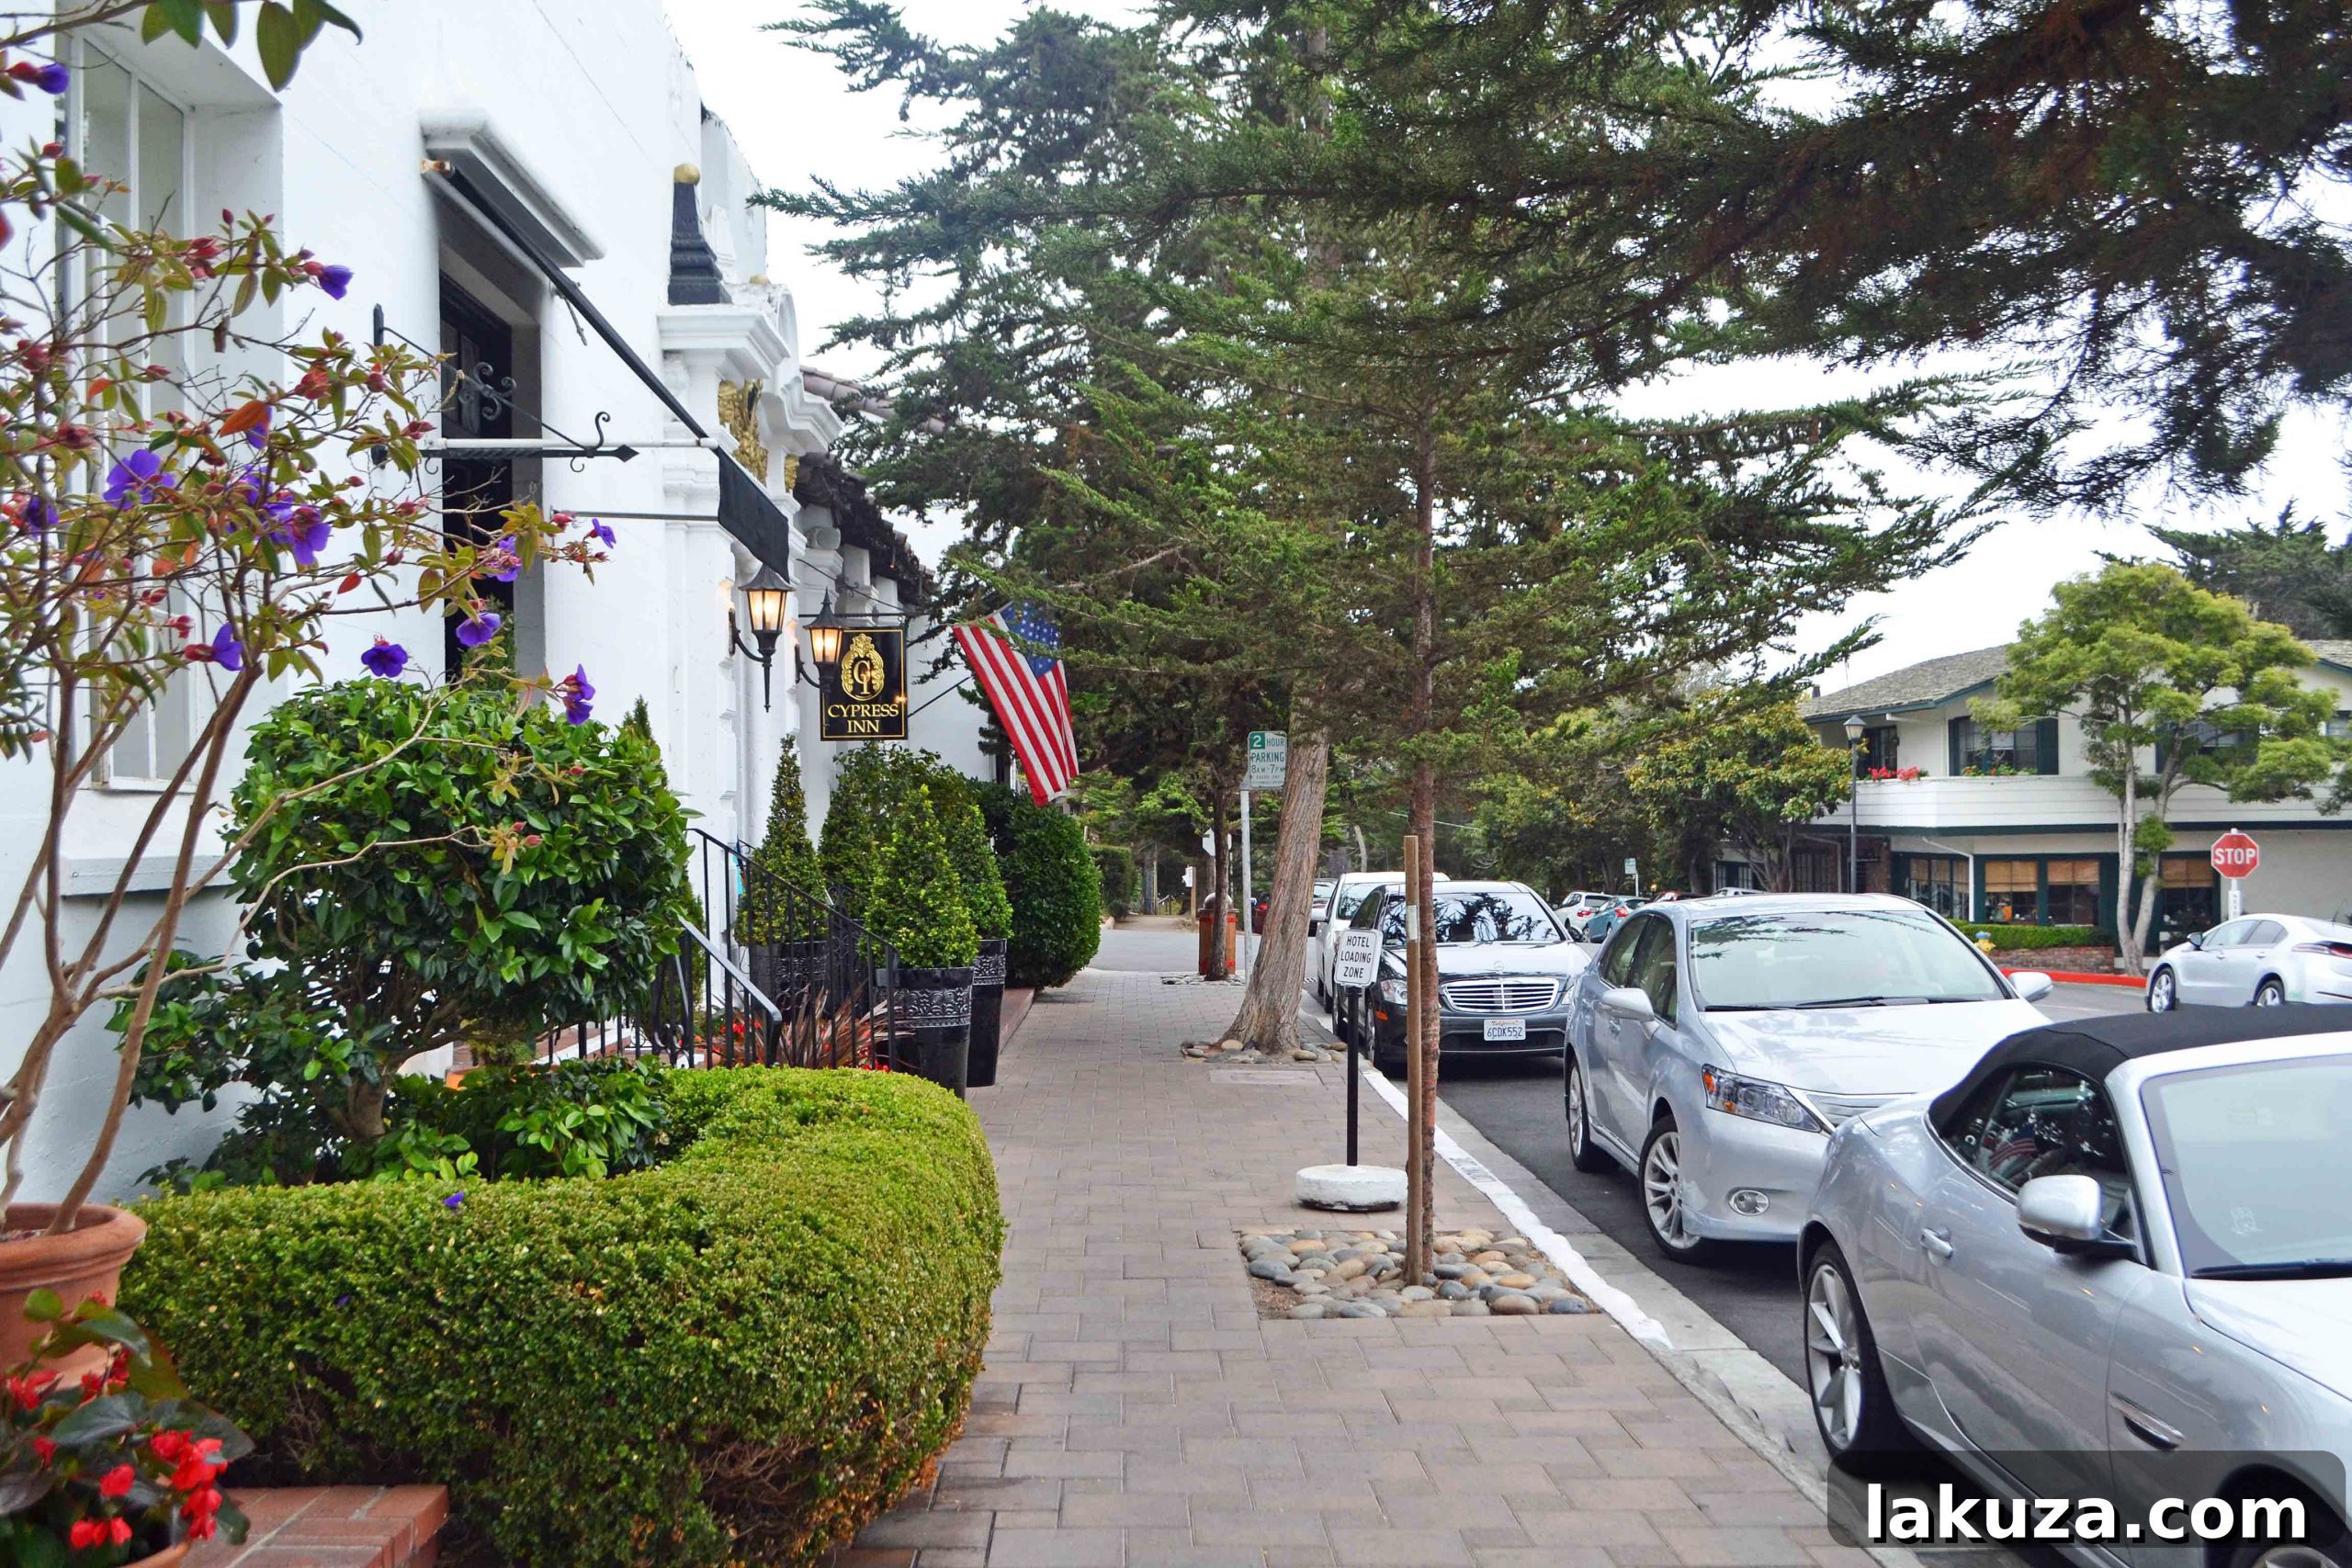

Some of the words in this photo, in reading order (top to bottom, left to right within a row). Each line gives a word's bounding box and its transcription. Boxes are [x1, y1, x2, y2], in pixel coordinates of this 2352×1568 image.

[828, 704, 899, 718] CYPRESS
[847, 719, 880, 733] INN
[1252, 735, 1262, 748] 2
[1266, 738, 1285, 748] HOUR
[1251, 752, 1284, 763] PARKING
[2214, 848, 2256, 865] STOP
[1346, 935, 1370, 948] HOTEL
[1340, 951, 1372, 964] LOADING
[1343, 966, 1364, 979] ZONE
[1487, 1026, 1523, 1038] 6CDK552
